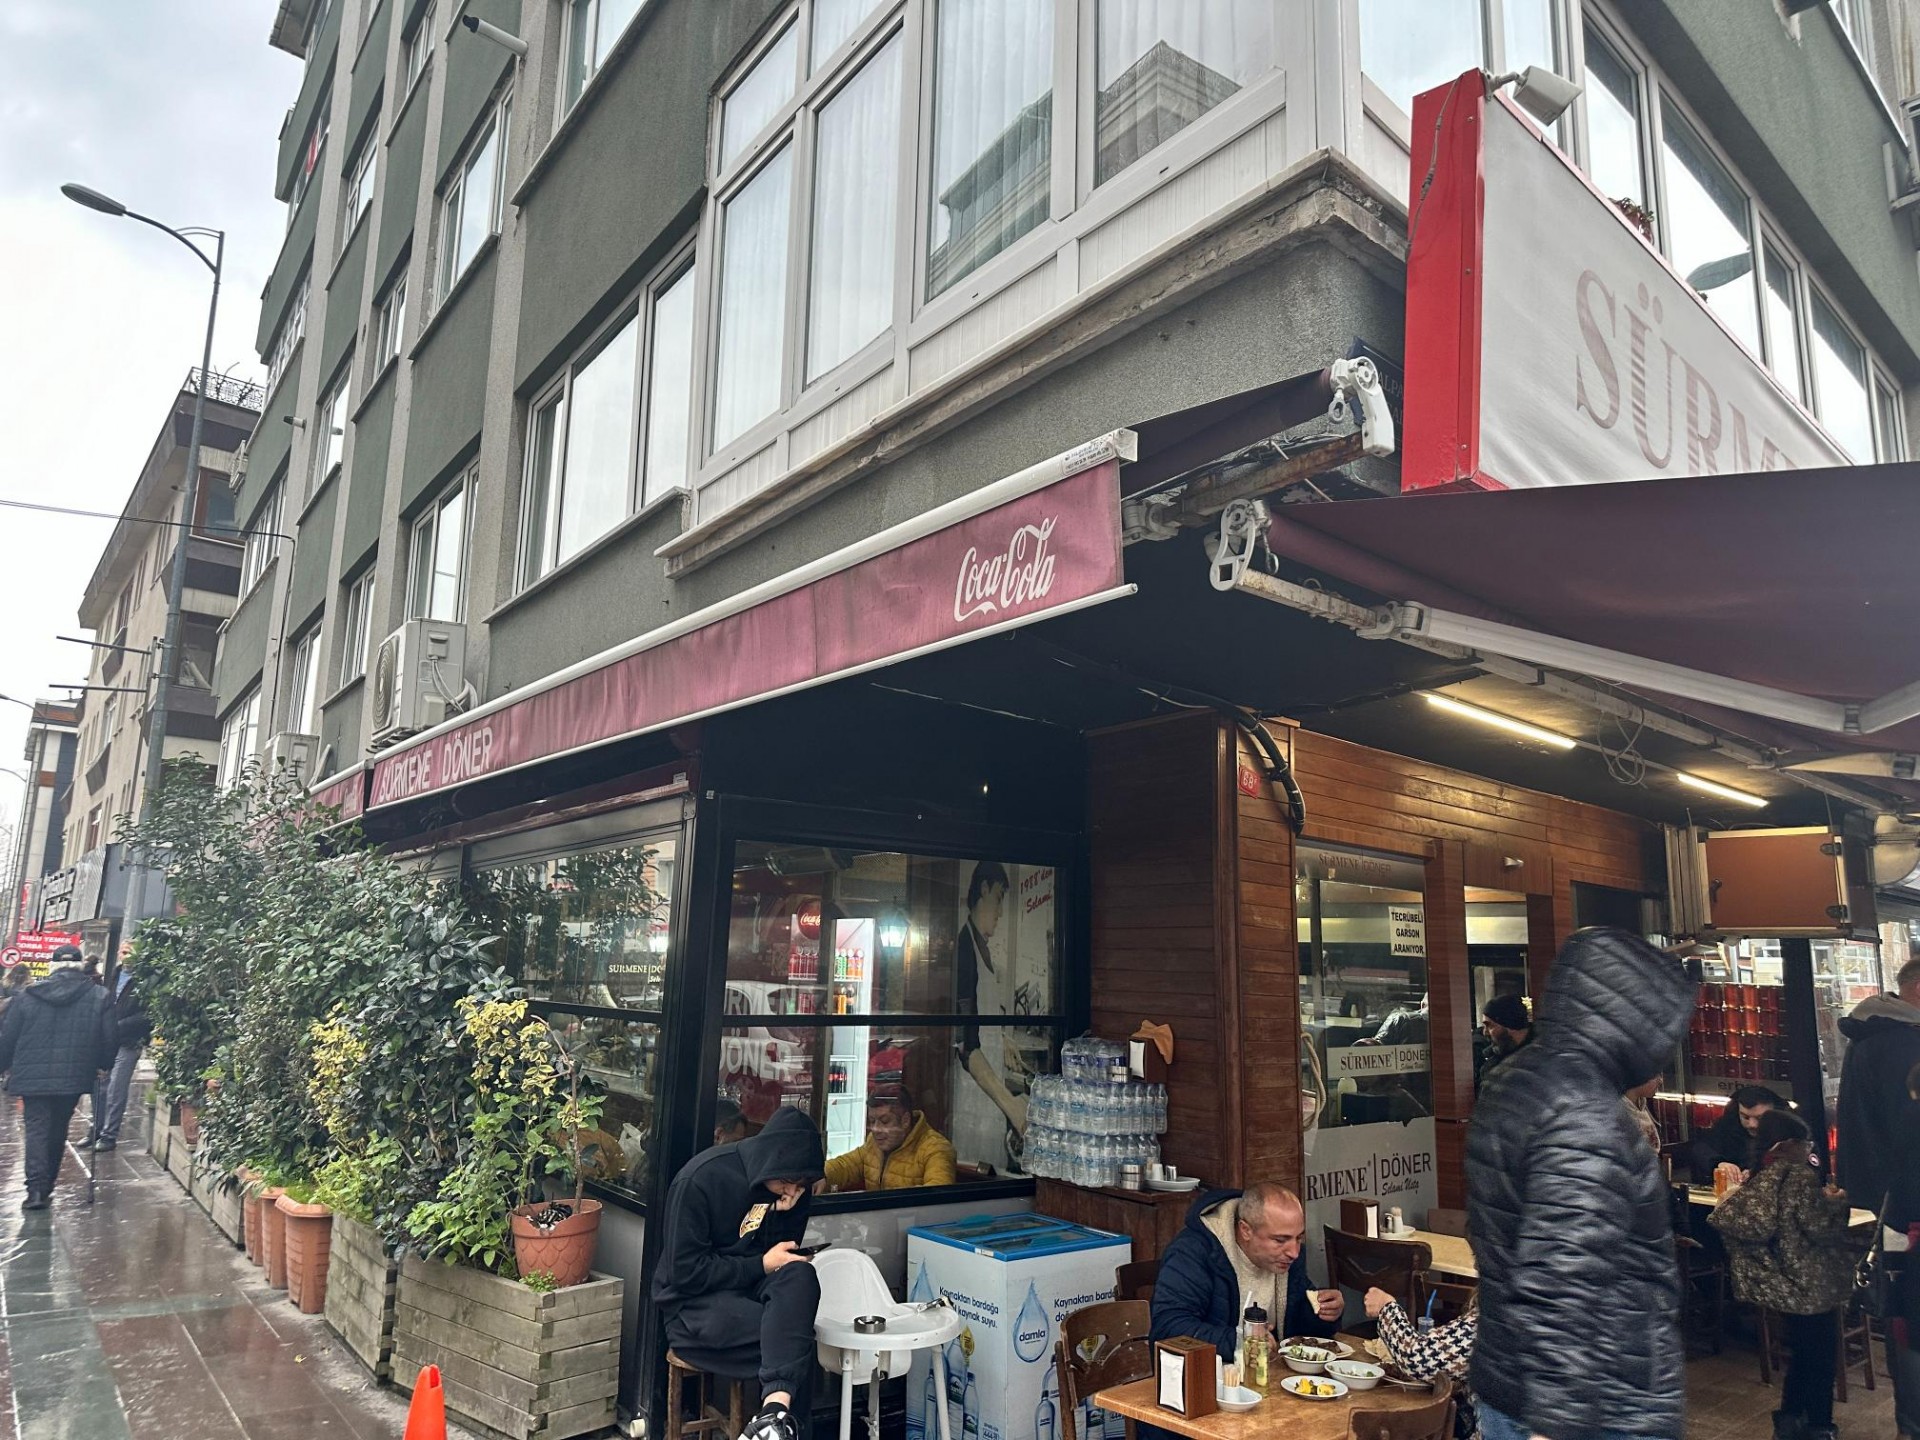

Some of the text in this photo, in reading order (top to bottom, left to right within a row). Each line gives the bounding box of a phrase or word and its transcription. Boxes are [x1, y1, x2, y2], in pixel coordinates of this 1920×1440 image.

[1575, 268, 1798, 476] SÜRM
[954, 514, 1058, 622] Coca-Cola
[441, 726, 493, 785] DÖNER
[1393, 943, 1424, 954] ARANIYOR
[1396, 928, 1420, 938] GARSON
[1306, 1152, 1432, 1201] RMENE DÖNER
[1054, 1289, 1115, 1309] Kaynaktan bard
[1019, 1329, 1046, 1342] damla
